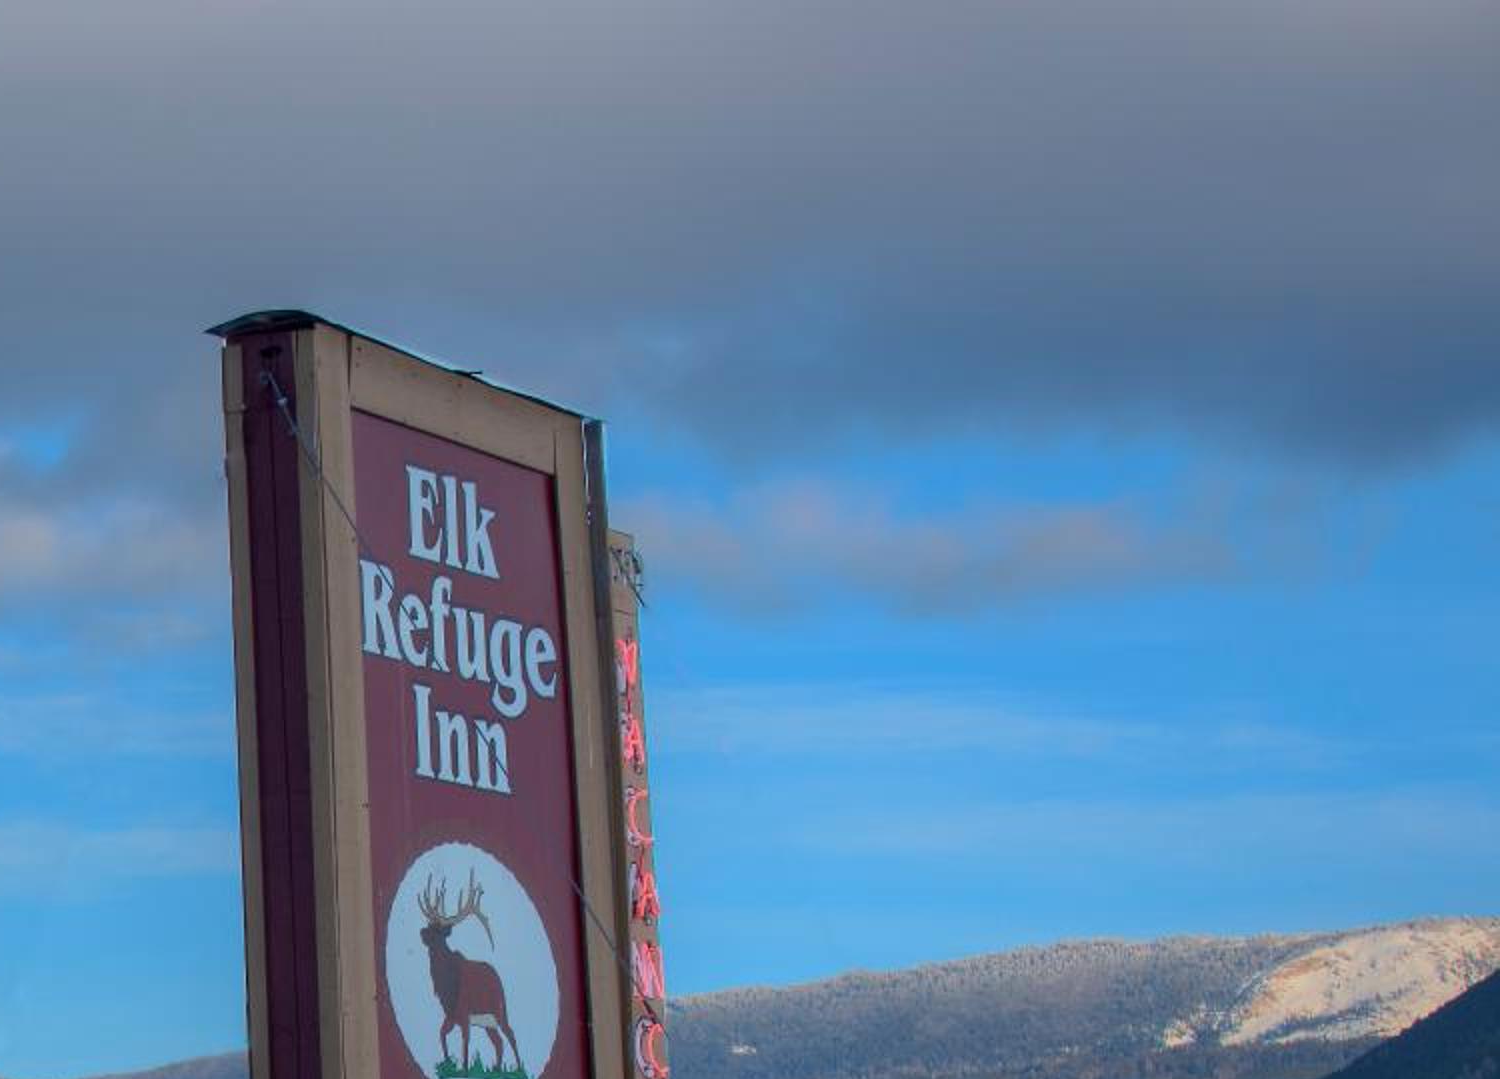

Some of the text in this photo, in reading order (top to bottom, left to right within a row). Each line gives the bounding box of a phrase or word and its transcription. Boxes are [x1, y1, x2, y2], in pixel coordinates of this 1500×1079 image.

[405, 463, 499, 579] Elk
[359, 559, 557, 718] Refuge
[413, 684, 511, 794] Inn
